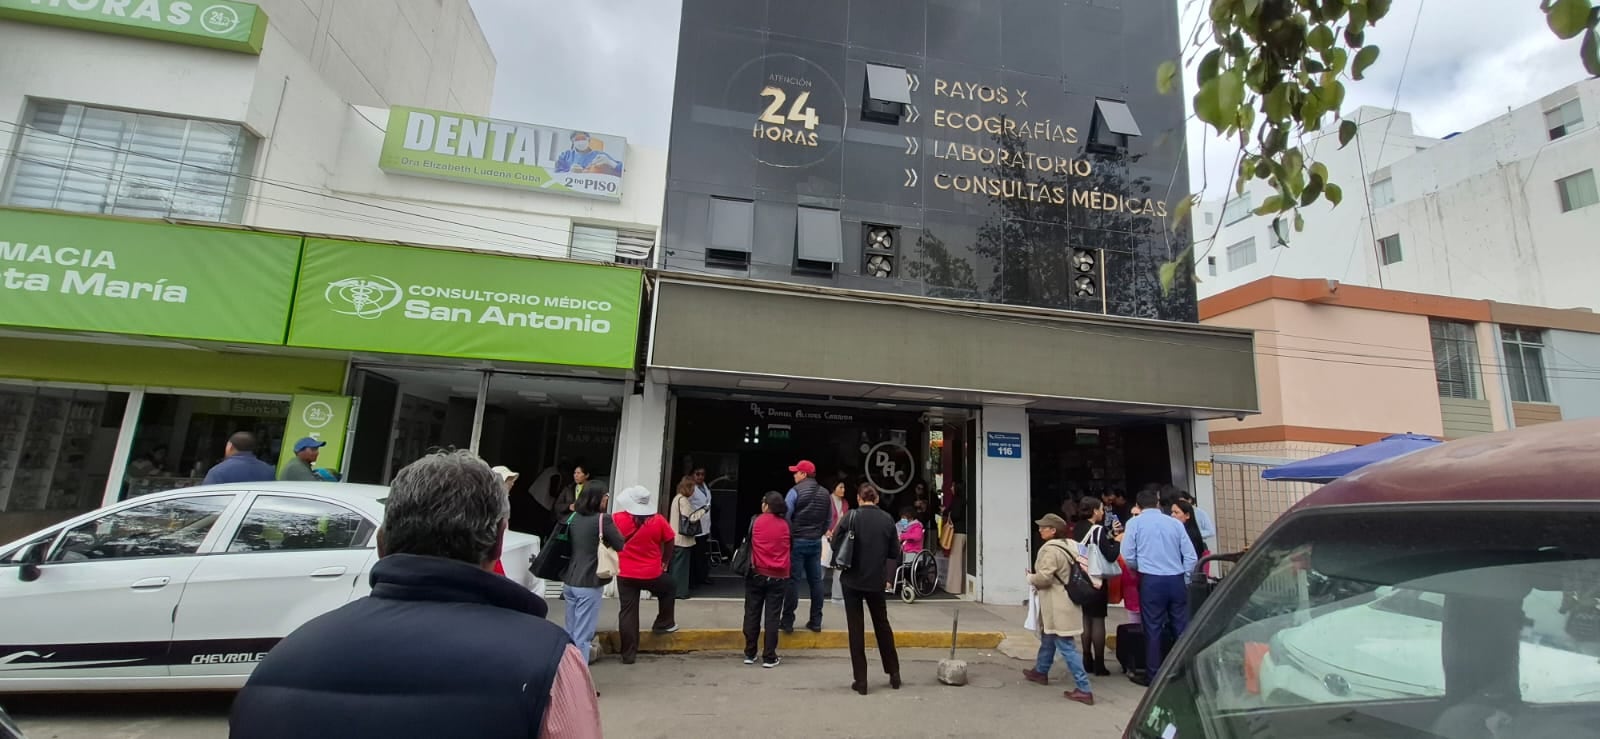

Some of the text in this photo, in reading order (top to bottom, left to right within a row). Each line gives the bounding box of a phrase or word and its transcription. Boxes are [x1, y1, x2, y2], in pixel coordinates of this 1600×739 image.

[30, 0, 193, 25] ORAS
[769, 73, 812, 87] ATENCIÓN
[934, 79, 1029, 107] RAYOS X
[758, 85, 819, 129] 24
[403, 111, 556, 168] DENTAL
[752, 124, 819, 147] HORAS
[934, 109, 1079, 144] ECOGRAFÍAS
[423, 160, 471, 173] Elizabeth
[514, 172, 541, 183] Cuba
[934, 140, 1092, 177] LABORATORIO
[585, 179, 617, 193] PISO
[934, 173, 1168, 218] CONSULTAS MÉDICAS
[0, 268, 188, 304] ta María
[408, 284, 612, 312] CONSULTORIO MÉDICO
[404, 300, 611, 334] San Antonio
[997, 446, 1013, 456] 116
[875, 451, 904, 486] DAC
[191, 652, 268, 665] CHEVROLE
